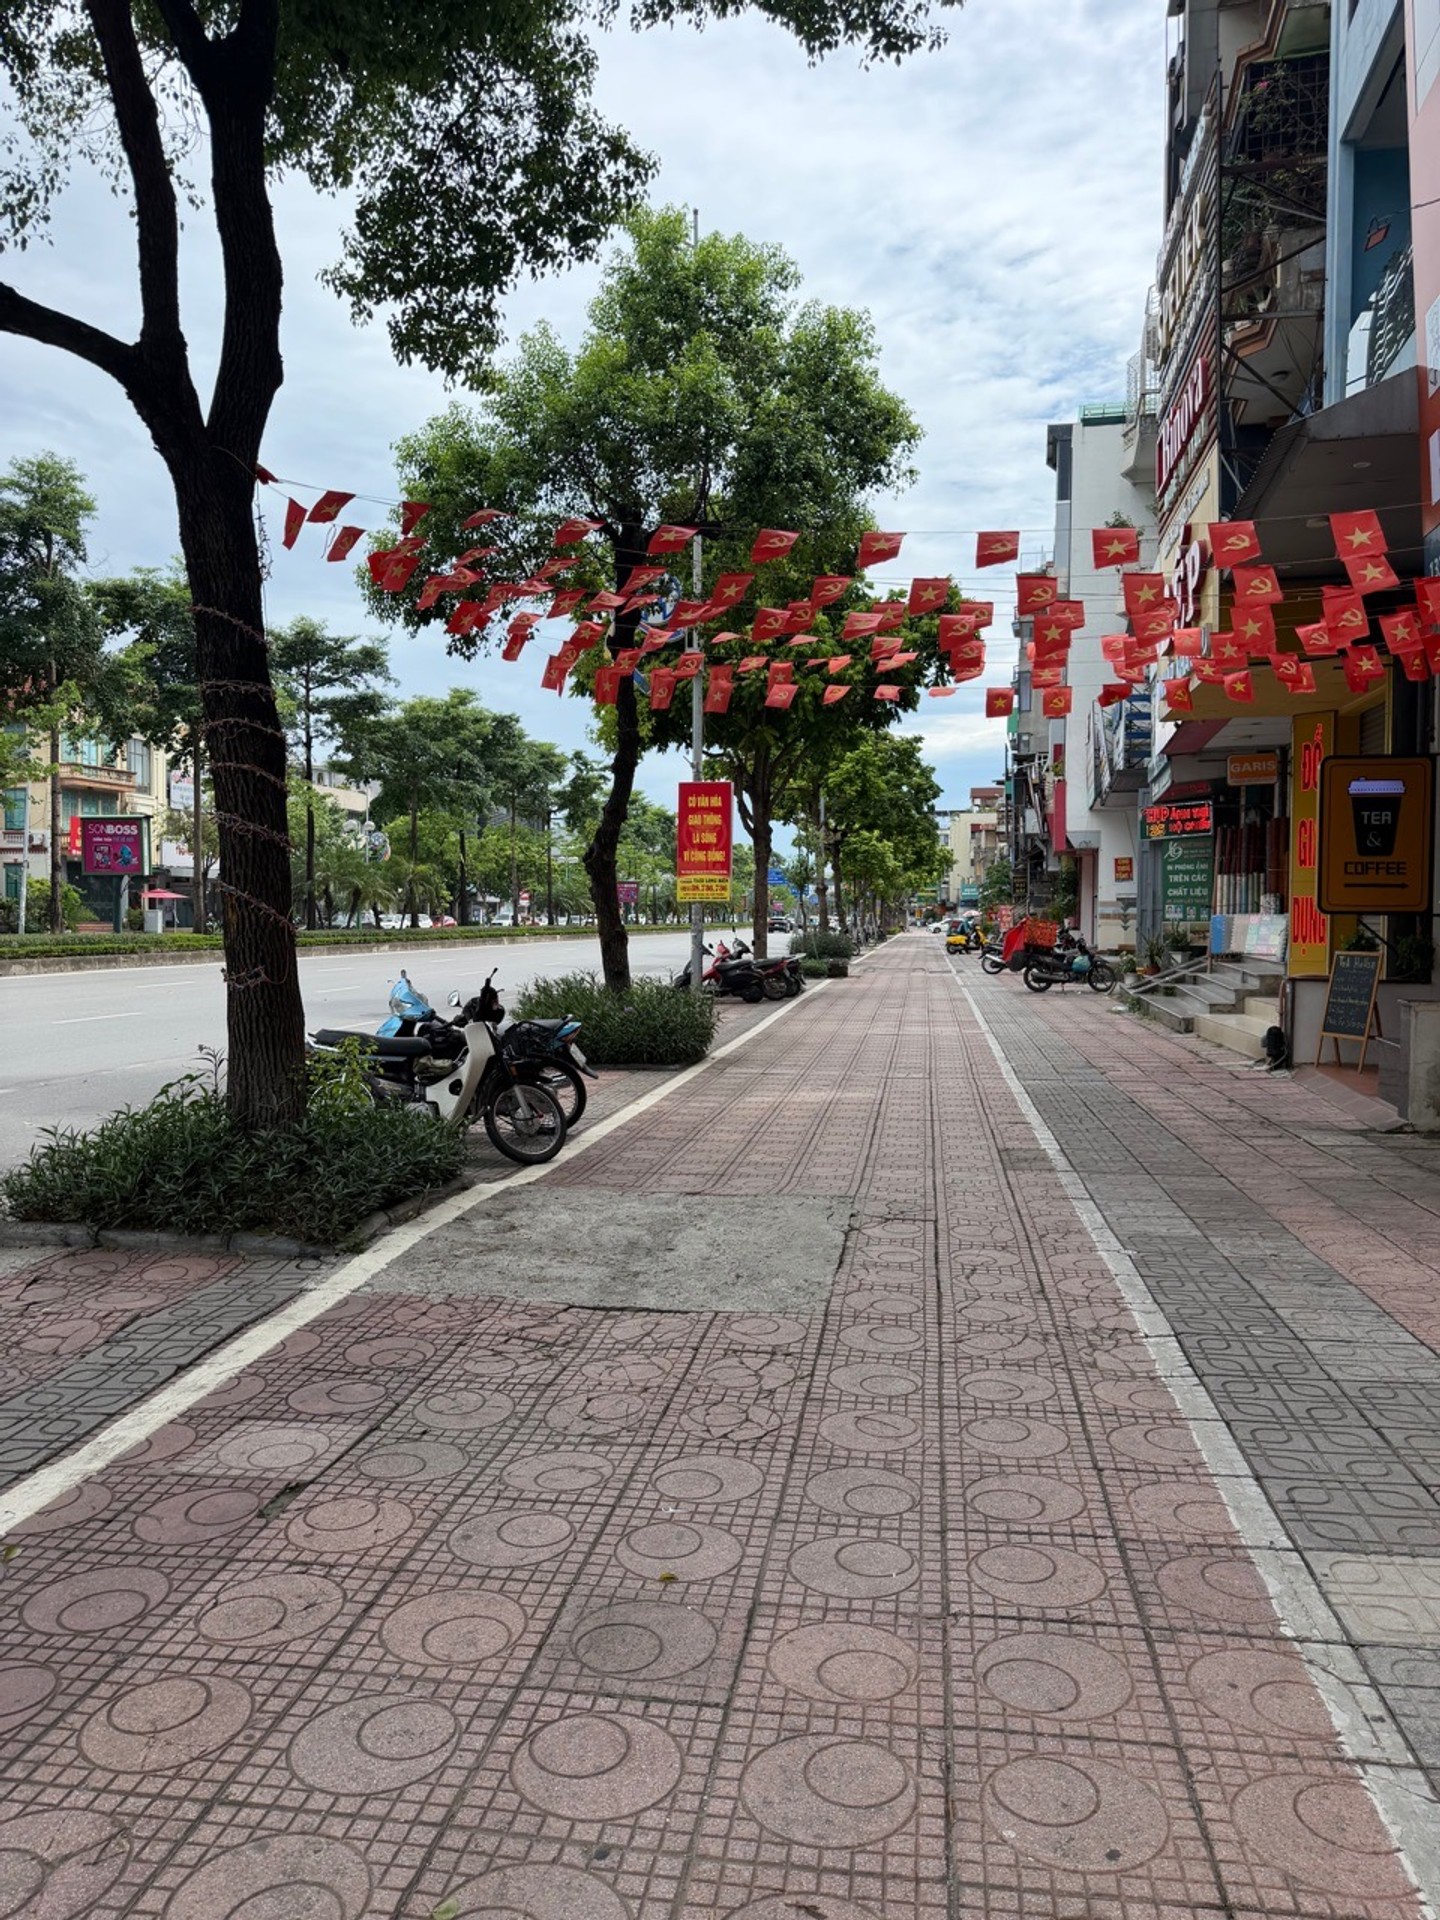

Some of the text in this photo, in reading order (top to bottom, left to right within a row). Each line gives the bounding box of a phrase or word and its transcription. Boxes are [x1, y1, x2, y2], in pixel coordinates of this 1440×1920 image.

[1230, 760, 1276, 773] GARIS
[1361, 811, 1392, 825] TEA
[1297, 818, 1317, 868] GI
[1366, 831, 1383, 847] &
[1344, 861, 1407, 876] COFFEE
[1168, 873, 1190, 883] TRÊN
